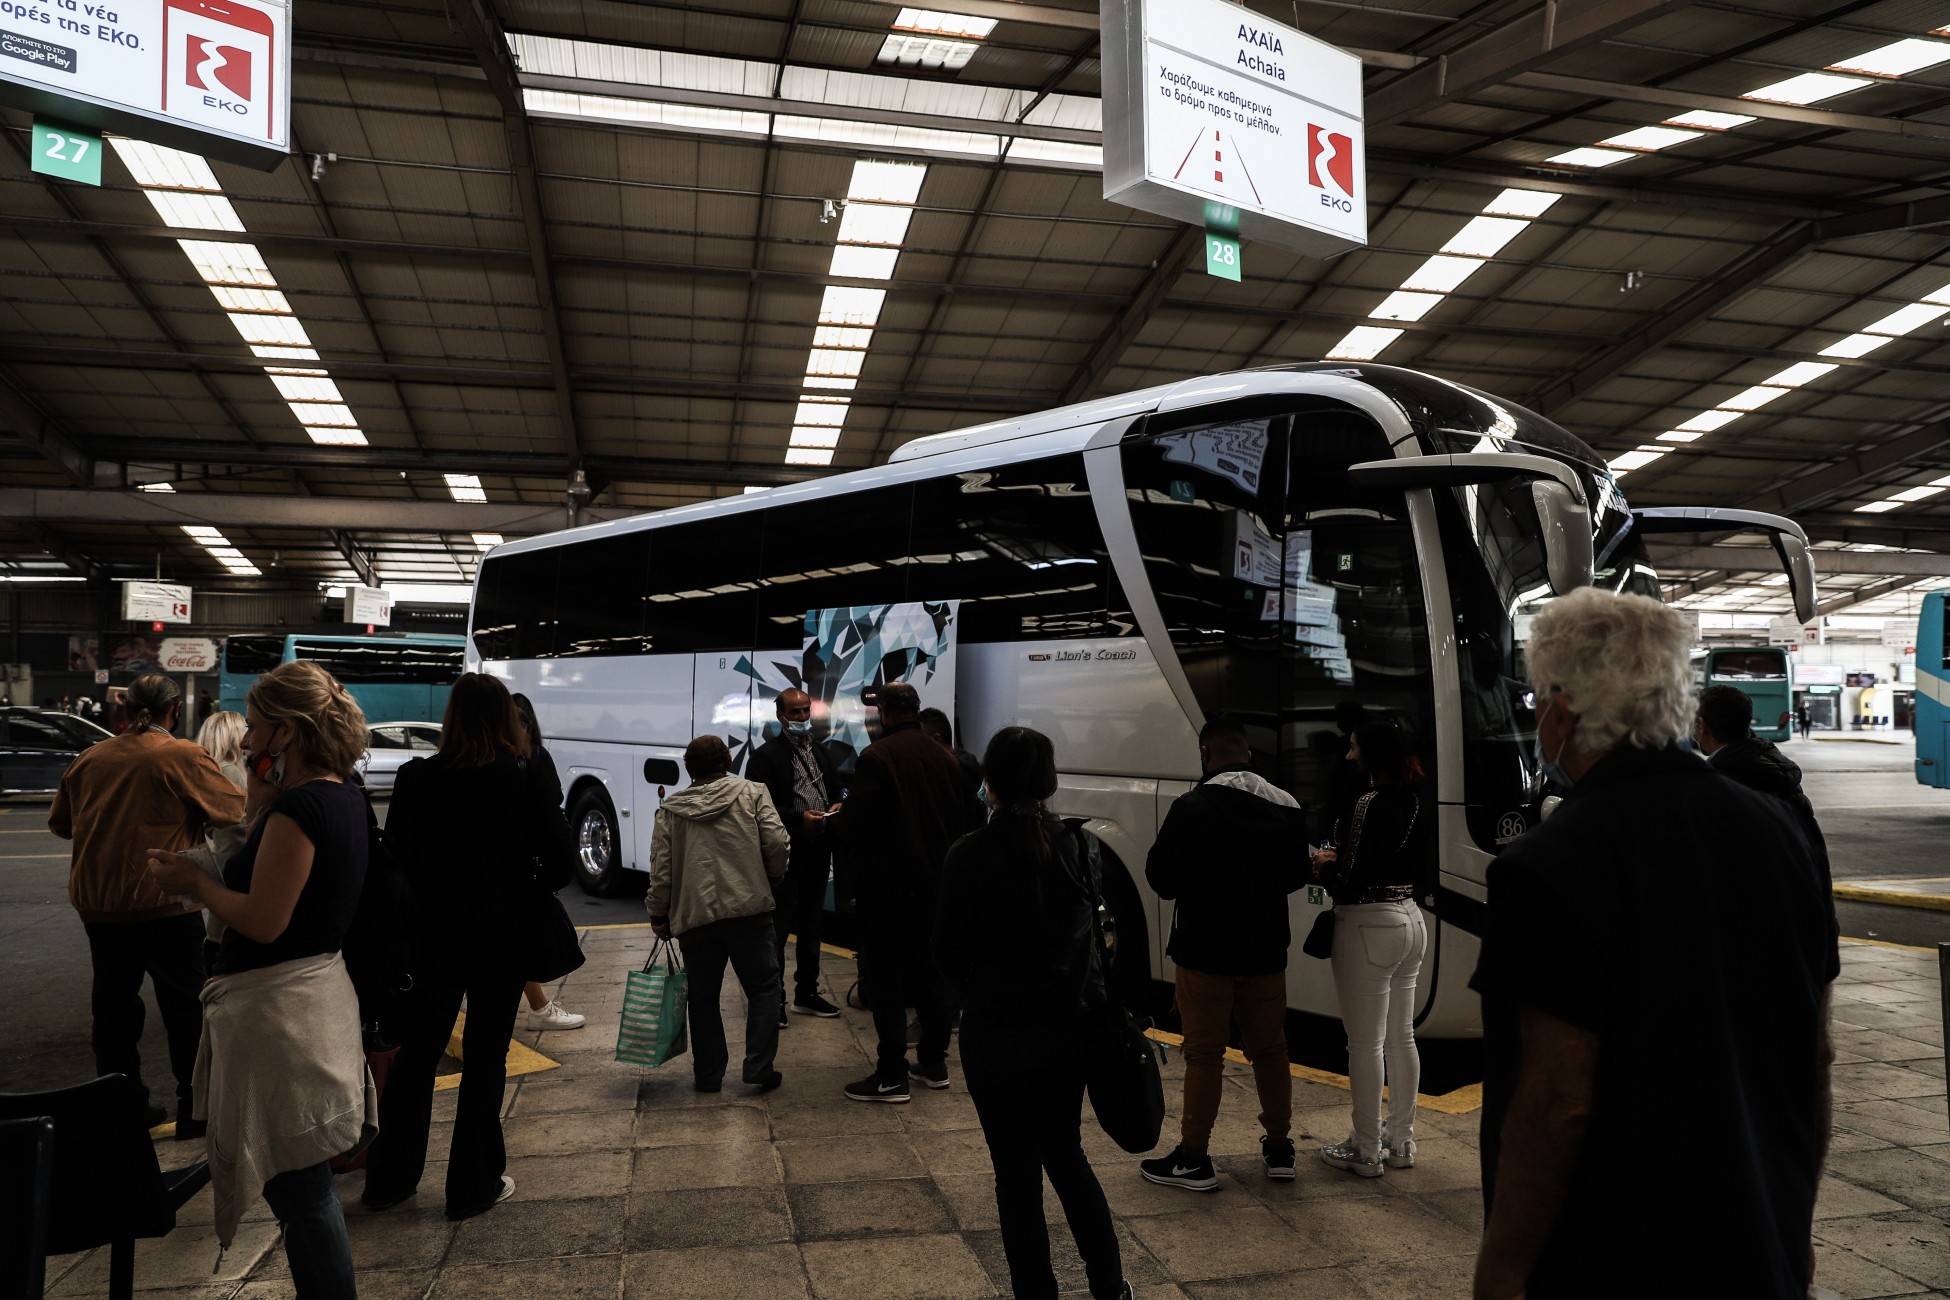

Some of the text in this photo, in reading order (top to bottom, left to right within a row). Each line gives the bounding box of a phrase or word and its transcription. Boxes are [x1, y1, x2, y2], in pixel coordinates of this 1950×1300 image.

[57, 0, 118, 23] τα νέα
[57, 17, 91, 35] της
[43, 44, 52, 52] ΤΟ
[53, 48, 66, 56] ΣΤΟ
[1238, 24, 1284, 56] ΑΧΑΪΑ
[1, 41, 70, 68] Google Play
[1237, 49, 1285, 81] Achaia
[1160, 65, 1272, 117] Χαράζουμε καθημερινά
[203, 95, 248, 115] EKO
[1160, 85, 1282, 136] το δρόμο προς το μέλλον.
[45, 133, 90, 164] 27
[1321, 194, 1352, 213] EKO
[1211, 241, 1235, 265] 28
[1055, 650, 1092, 661] Lion's
[1095, 650, 1137, 660] Coach
[1502, 817, 1523, 837] 86
